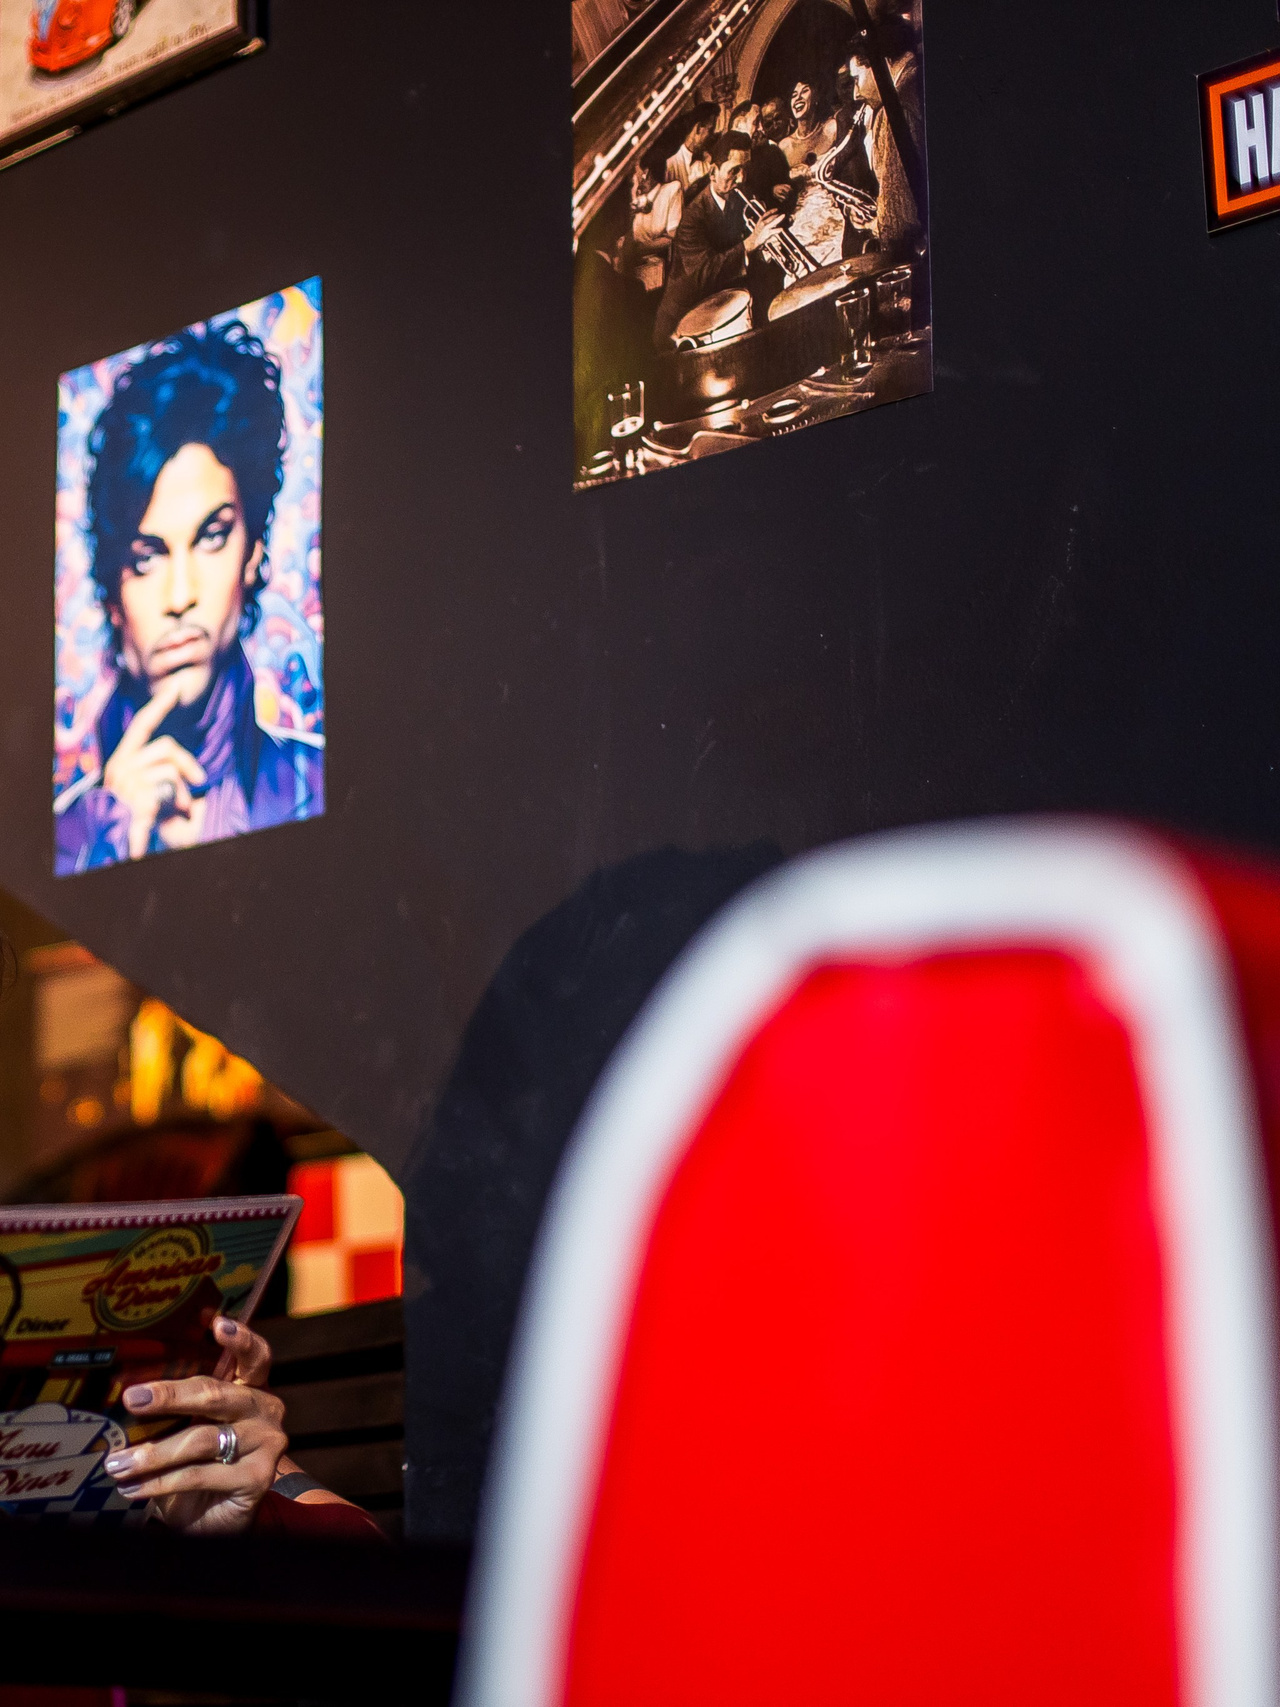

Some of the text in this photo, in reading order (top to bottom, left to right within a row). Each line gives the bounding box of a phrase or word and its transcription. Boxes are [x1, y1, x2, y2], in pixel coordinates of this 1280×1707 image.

[1232, 84, 1280, 186] H
[83, 1255, 222, 1295] American
[113, 1284, 181, 1311] Diner
[16, 1317, 70, 1334] Diner
